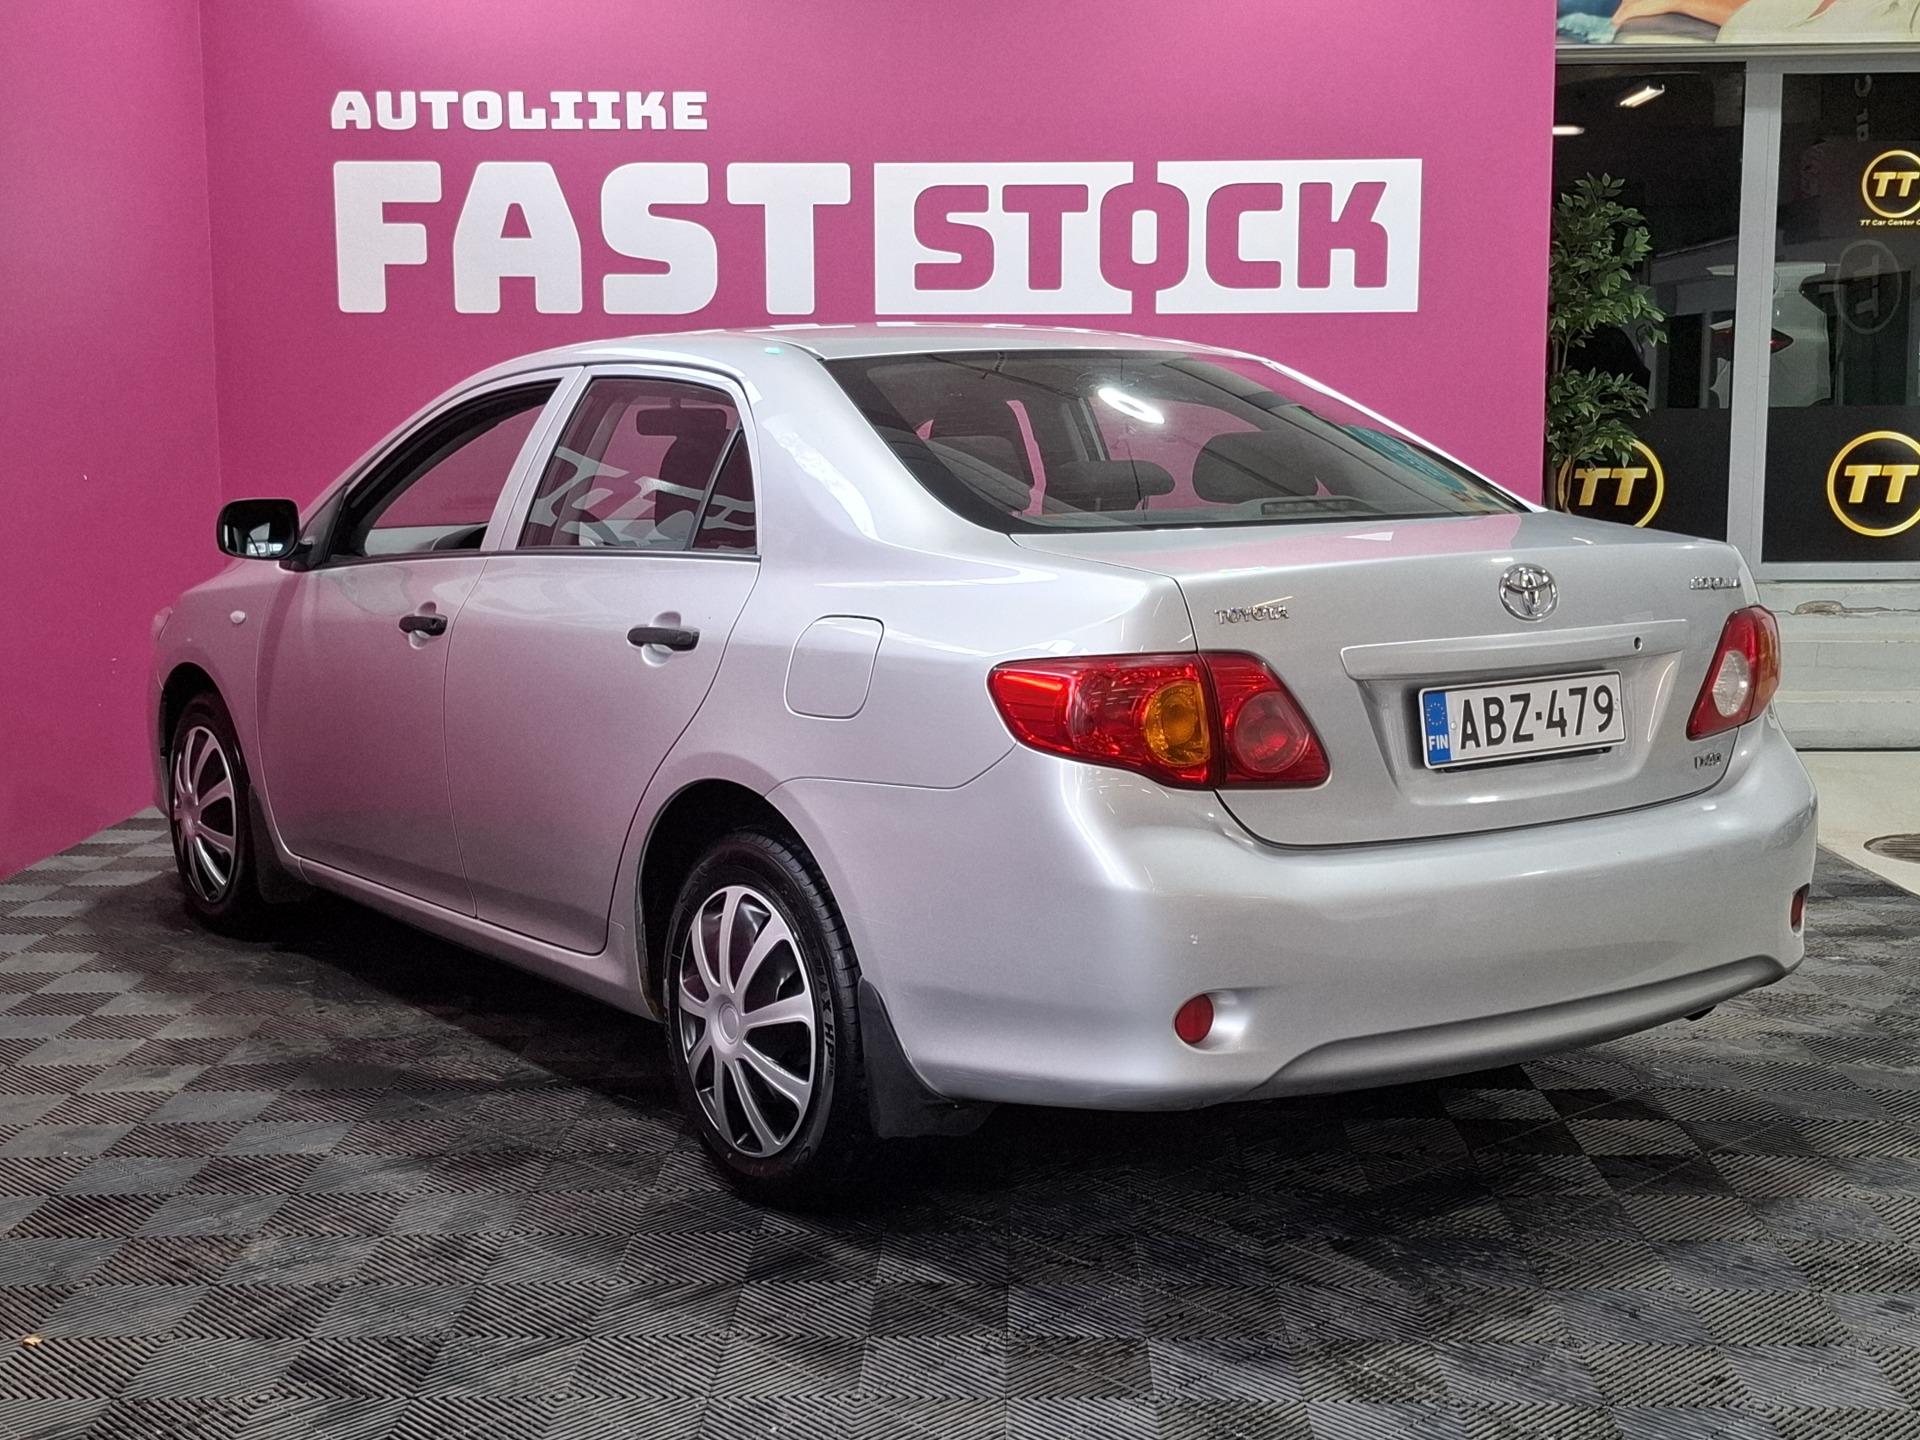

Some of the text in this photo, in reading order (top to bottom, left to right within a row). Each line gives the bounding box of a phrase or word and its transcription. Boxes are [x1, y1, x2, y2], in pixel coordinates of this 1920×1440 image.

[331, 91, 708, 130] AUTOLIIKE
[1873, 171, 1920, 197] TT
[333, 160, 1388, 314] FAST STOCK
[1574, 467, 1648, 506] TT
[1844, 464, 1919, 503] TT
[1214, 605, 1289, 625] TOYOTA
[1460, 684, 1614, 750] ABZ-479
[1429, 734, 1449, 751] FIN
